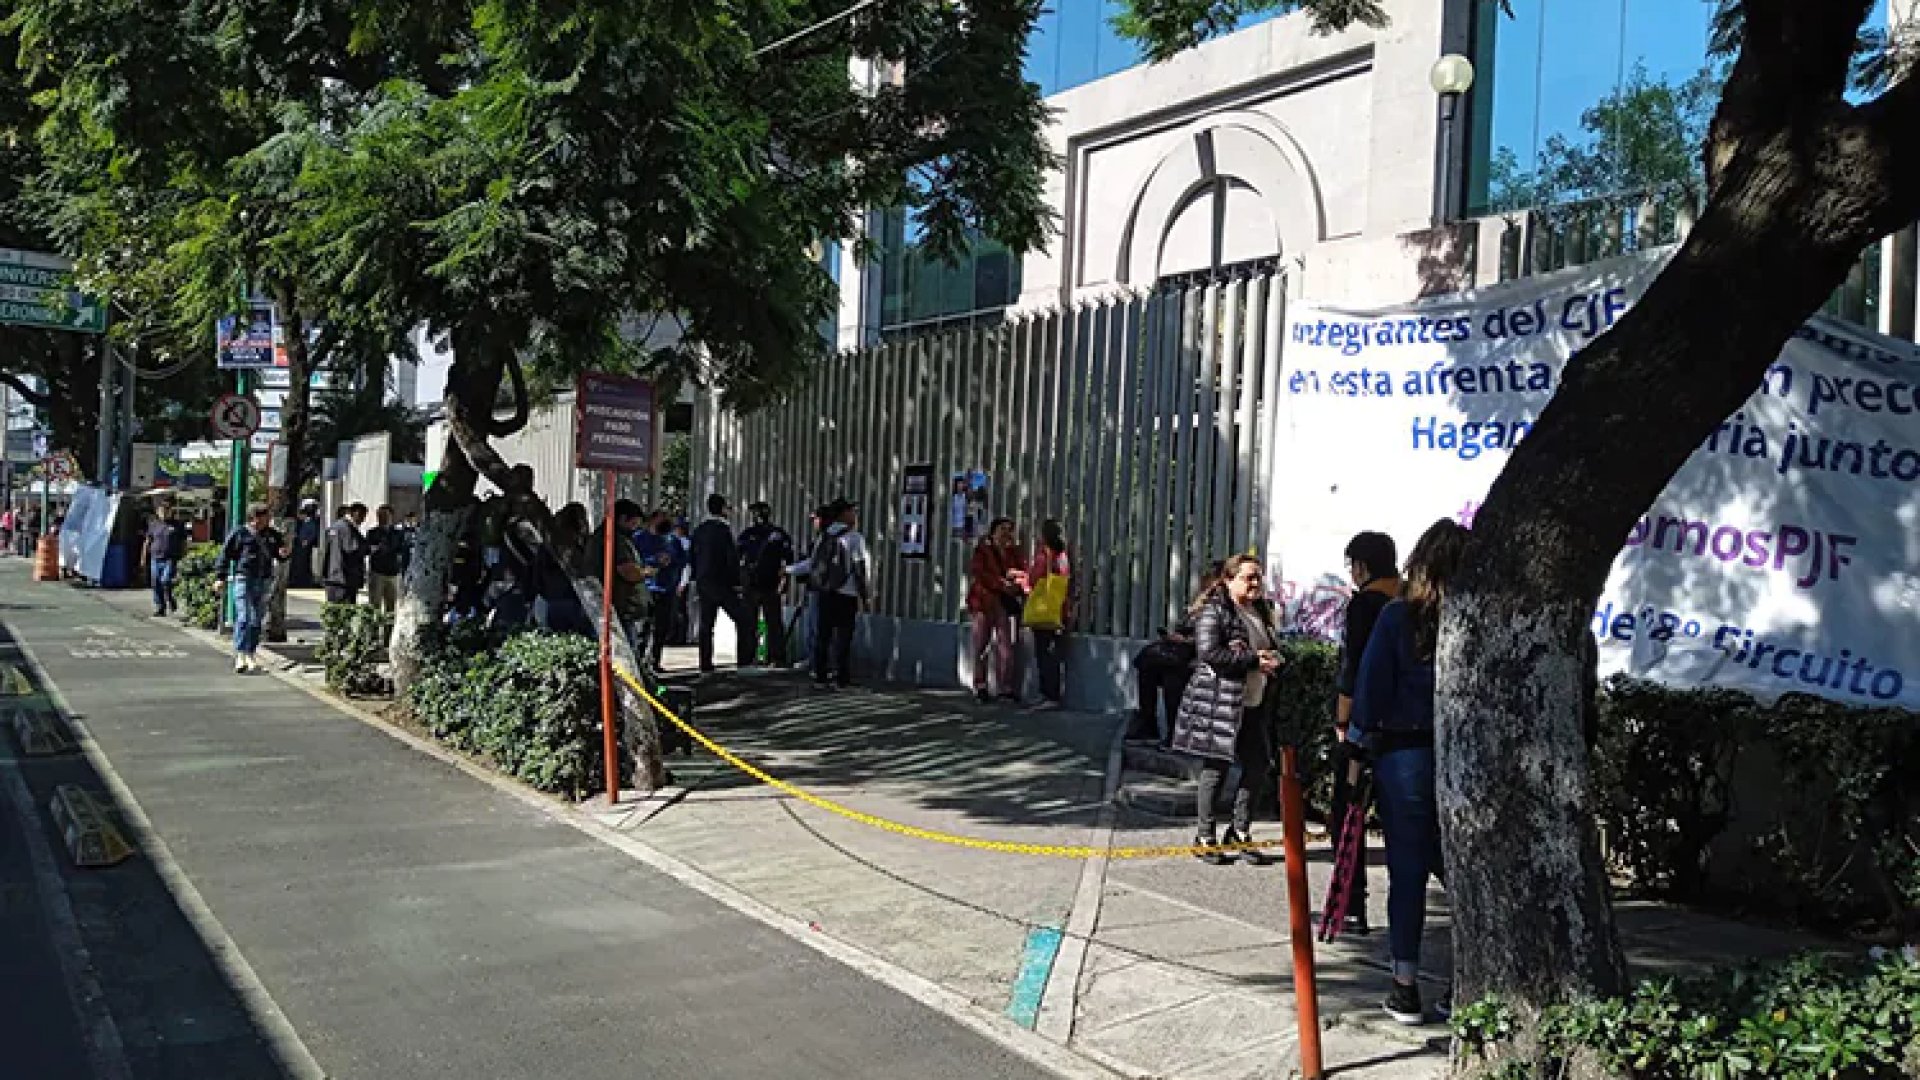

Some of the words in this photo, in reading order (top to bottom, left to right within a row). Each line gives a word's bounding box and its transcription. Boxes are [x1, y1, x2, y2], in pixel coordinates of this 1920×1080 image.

[1482, 299, 1546, 339] del
[1561, 288, 1625, 338] CJF
[1329, 367, 1392, 397] esta
[1403, 359, 1550, 396] afrenta
